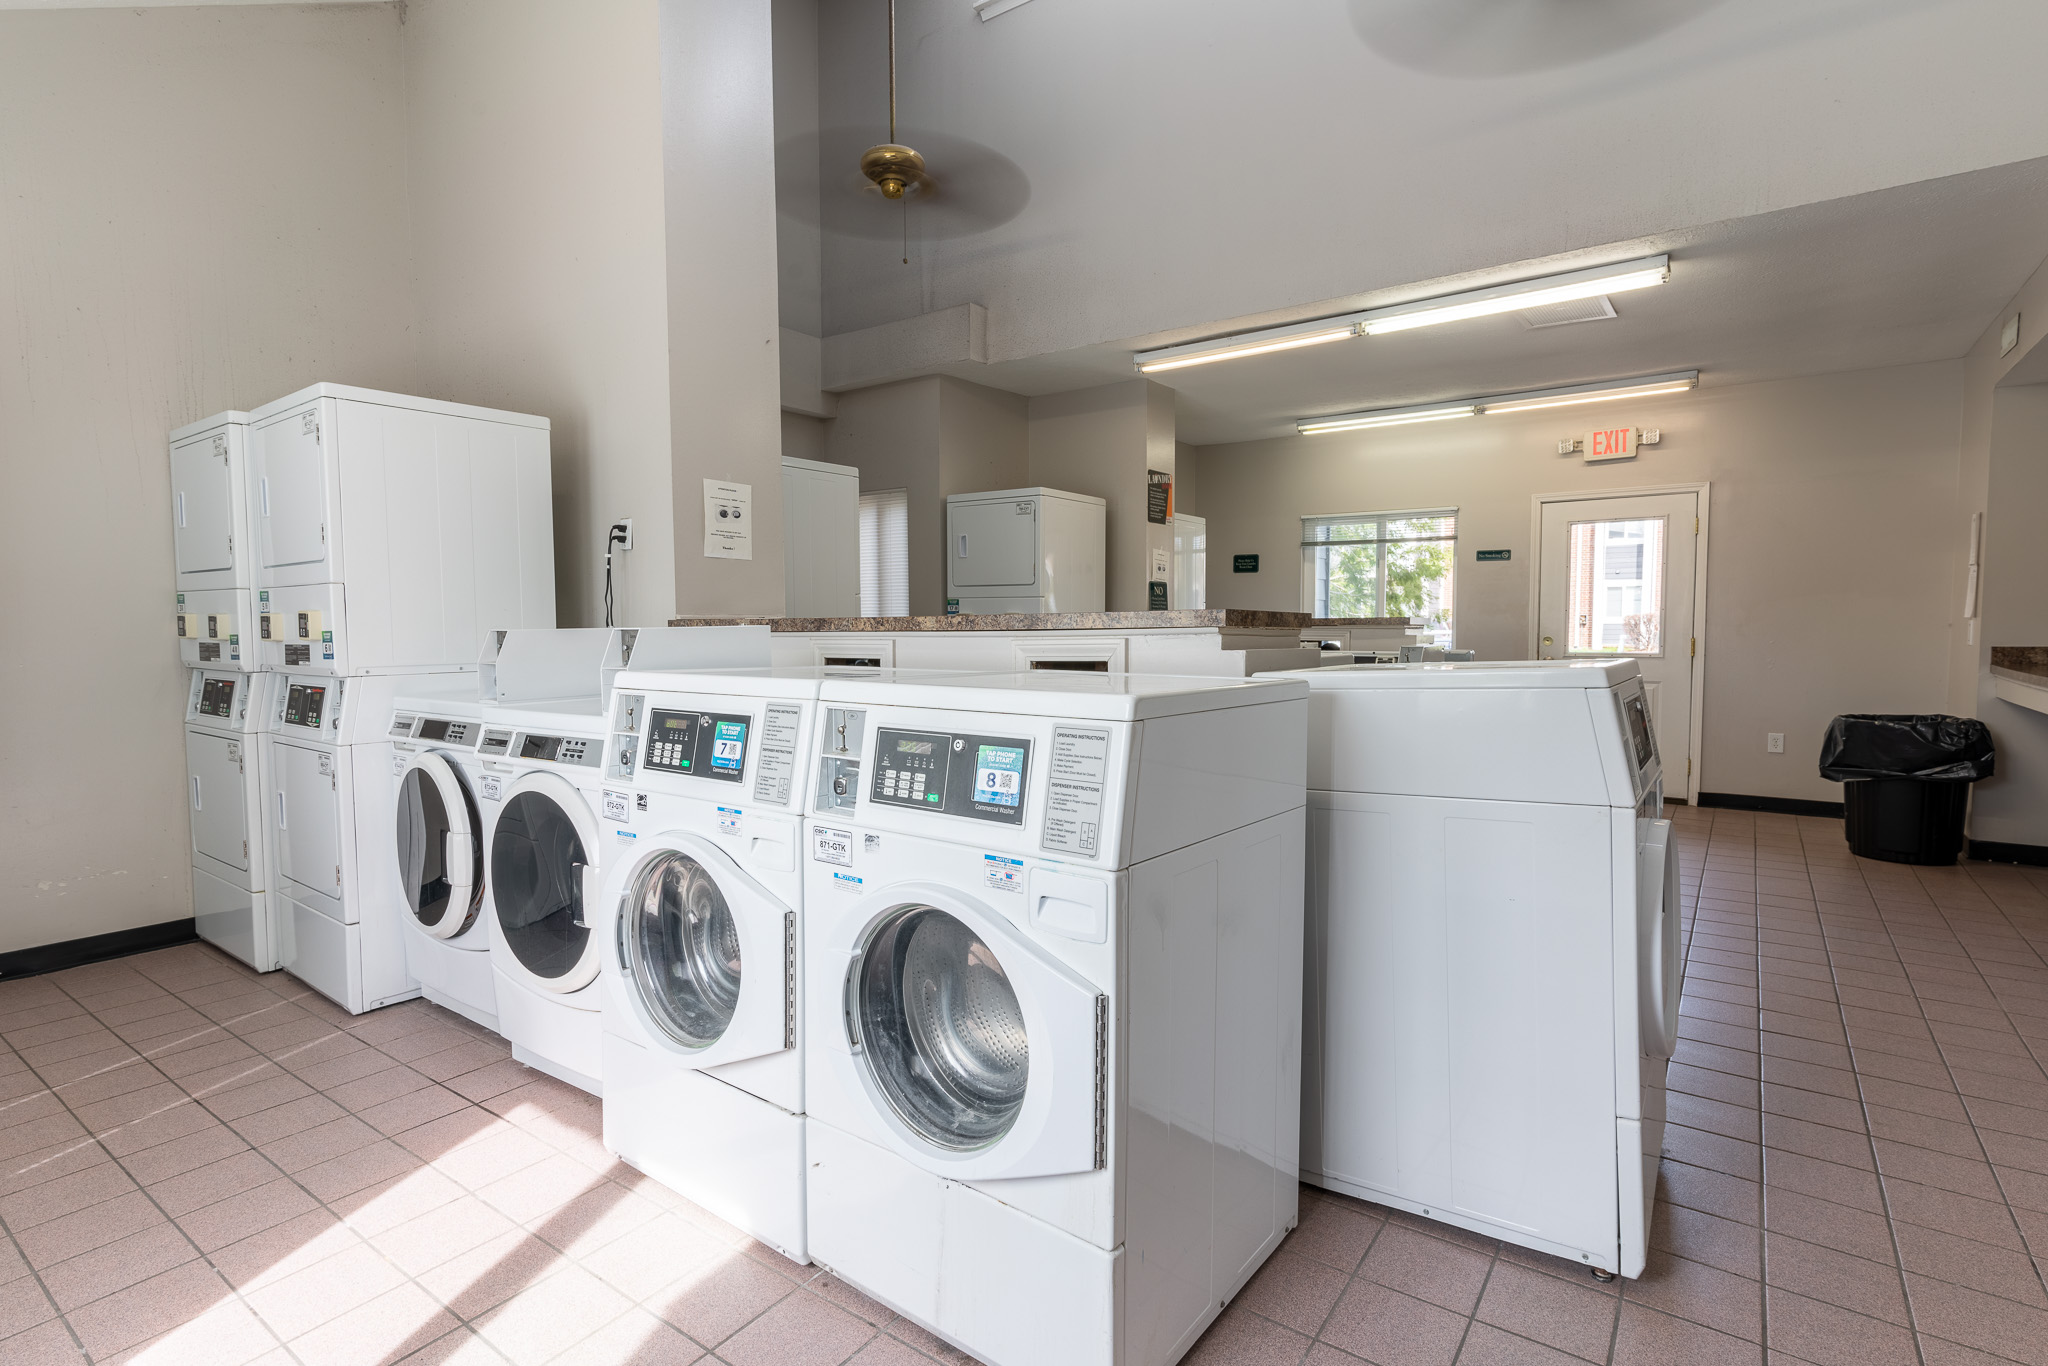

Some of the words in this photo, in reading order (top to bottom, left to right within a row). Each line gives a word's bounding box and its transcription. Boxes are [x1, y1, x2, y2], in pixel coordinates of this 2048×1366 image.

[1592, 428, 1630, 455] EXIT
[1154, 586, 1163, 595] NO
[721, 743, 727, 755] 7
[986, 772, 996, 788] 8
[975, 804, 998, 812] Commercial
[820, 841, 846, 852] 871-GTK
